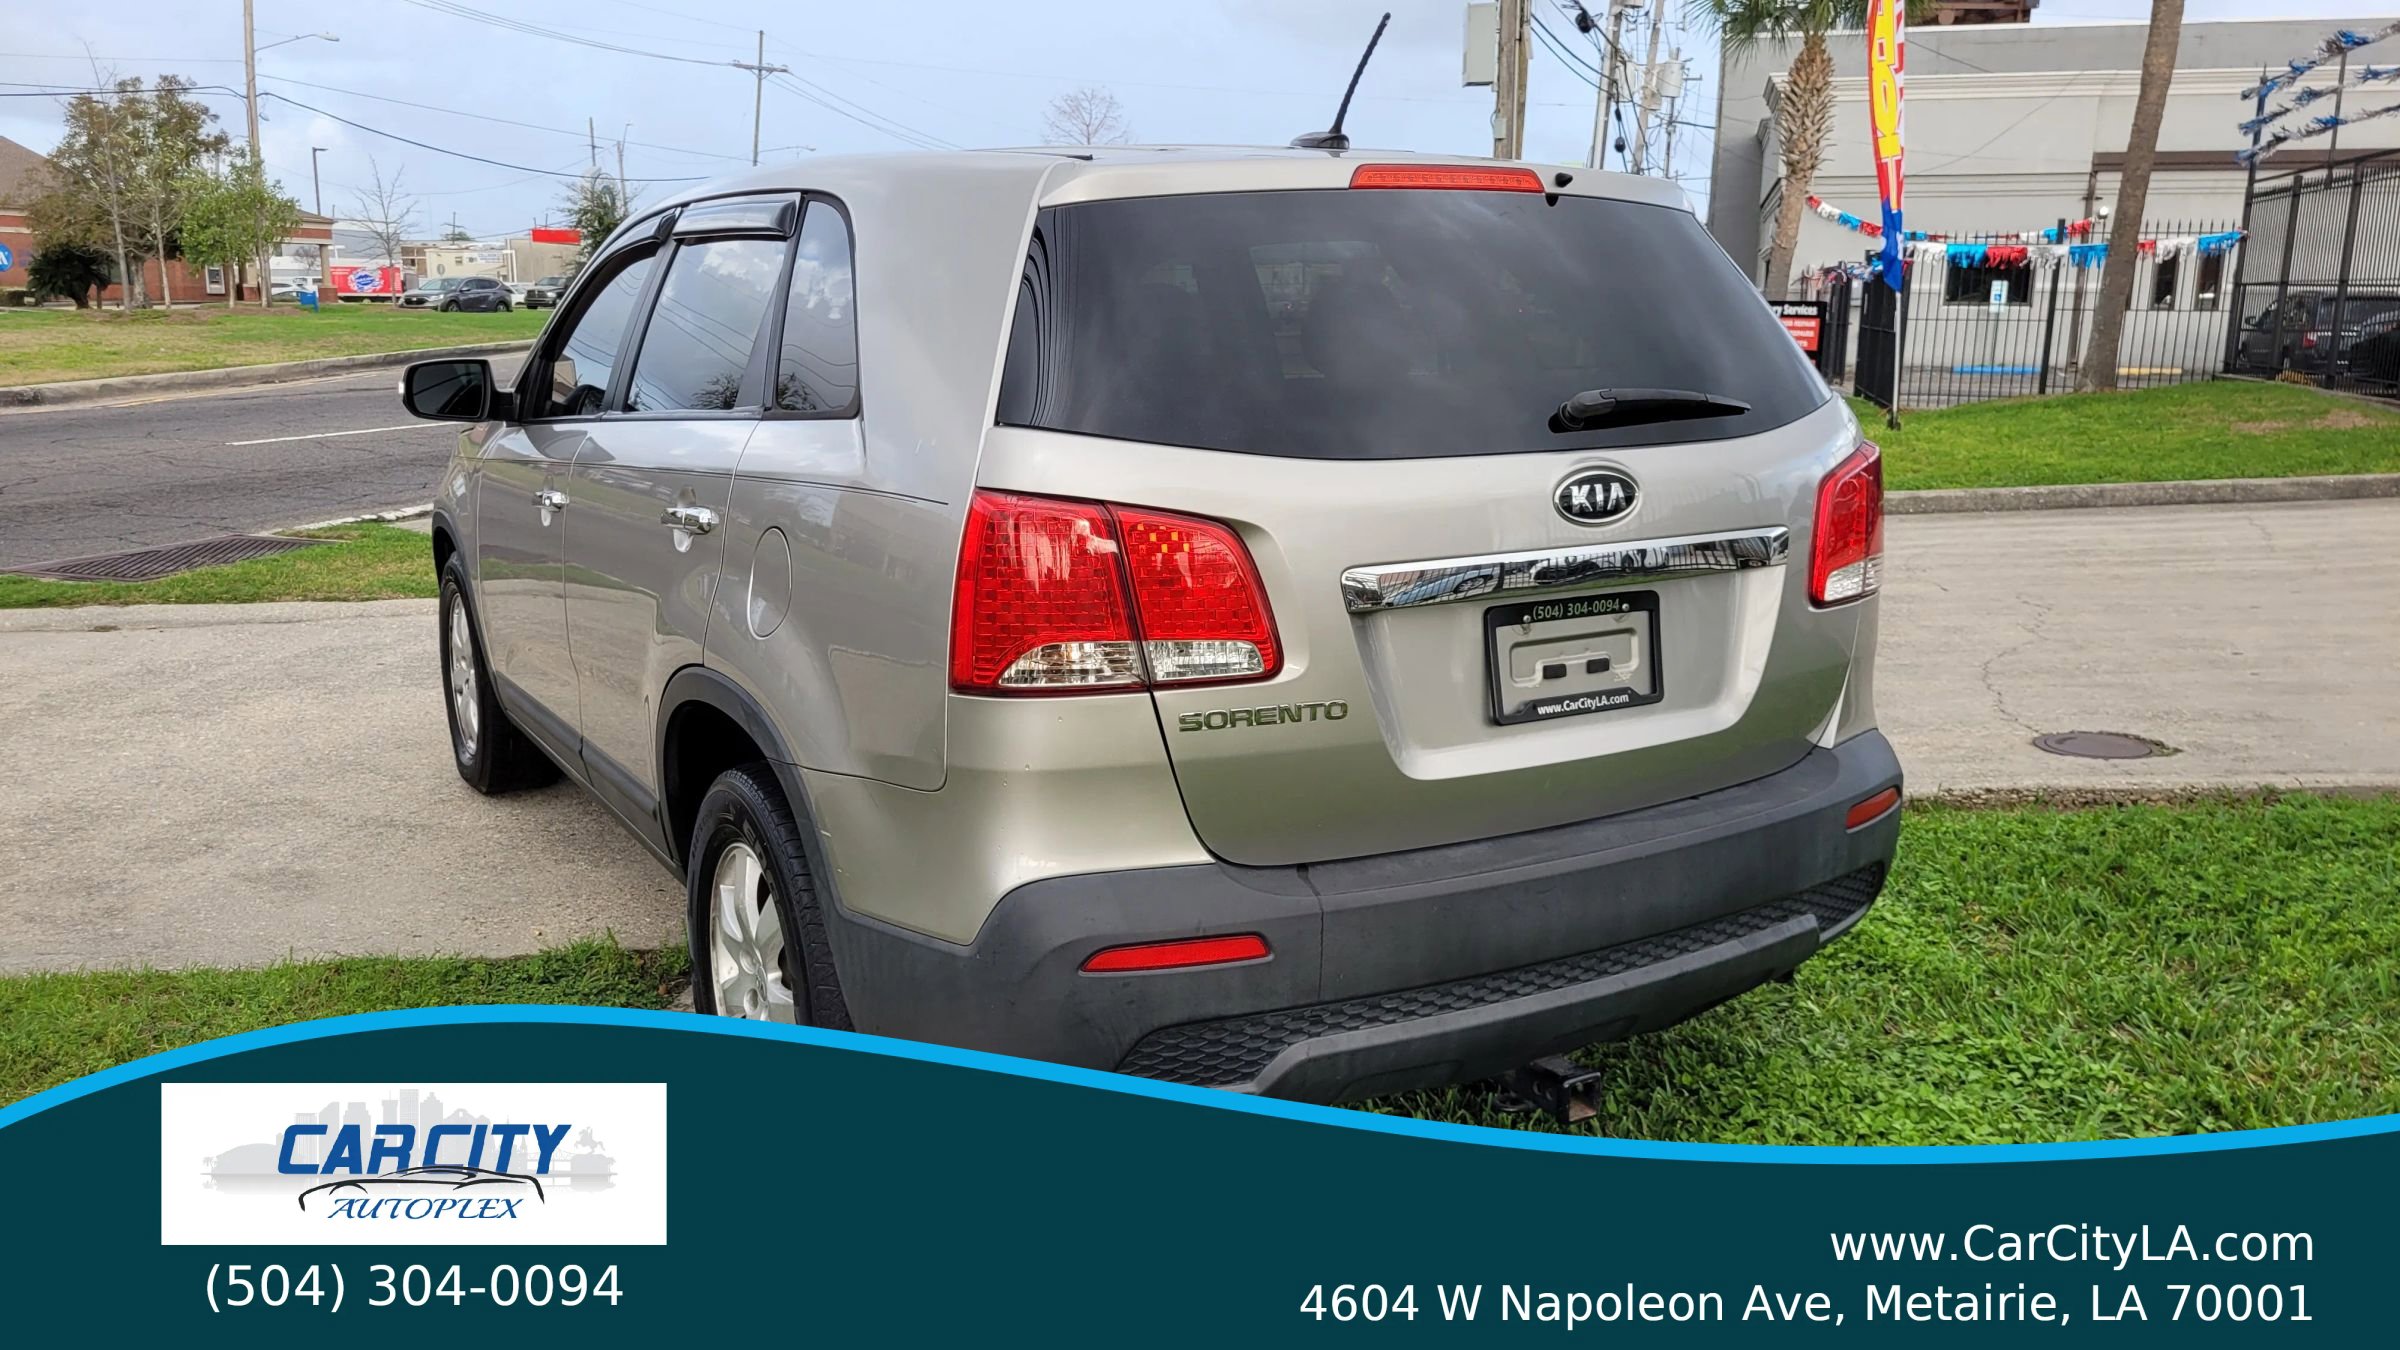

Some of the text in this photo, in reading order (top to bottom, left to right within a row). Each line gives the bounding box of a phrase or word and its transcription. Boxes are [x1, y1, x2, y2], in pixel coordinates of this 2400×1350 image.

[1783, 304, 1818, 316] Services
[1569, 482, 1627, 514] KIA
[1532, 598, 1620, 620] (504) 304-0094
[1179, 699, 1348, 732] SORENTO
[1536, 693, 1630, 716] www.CarCityLA.com
